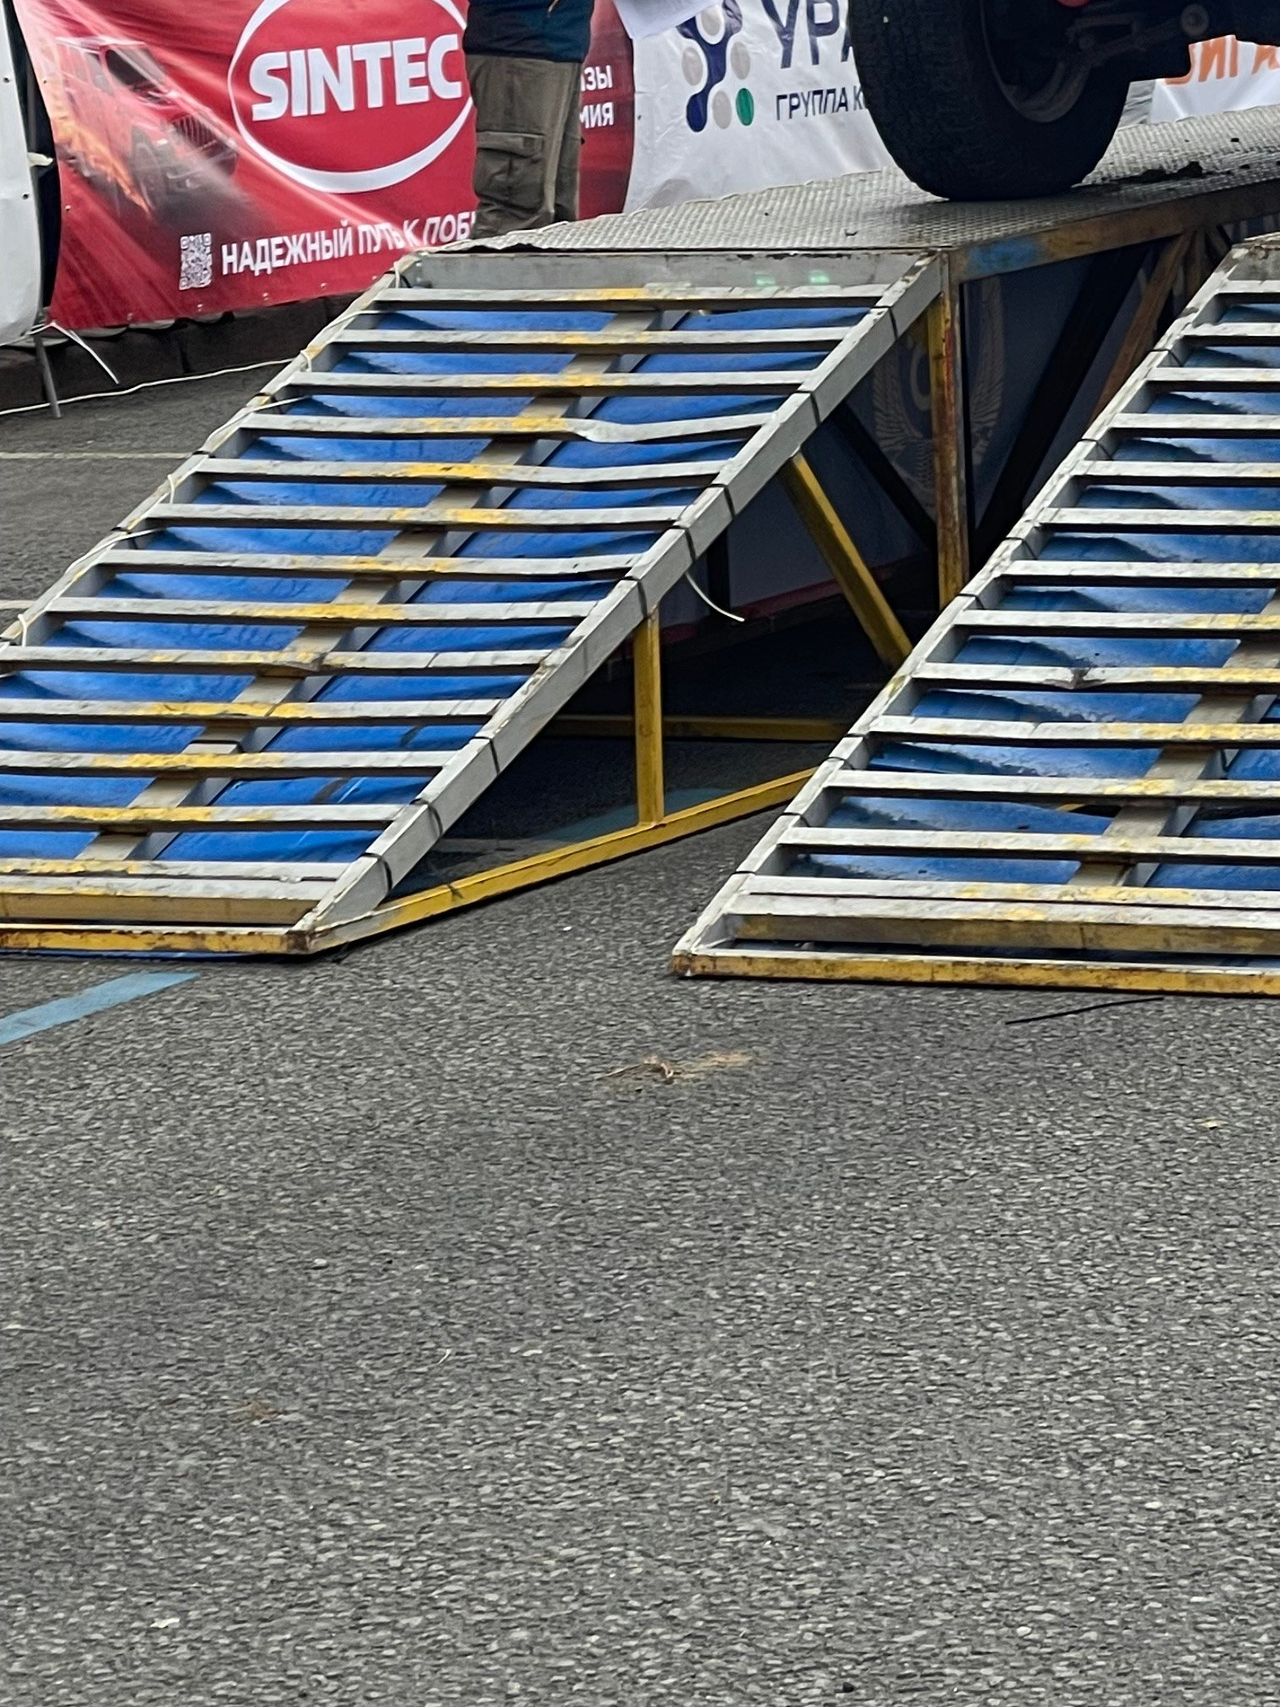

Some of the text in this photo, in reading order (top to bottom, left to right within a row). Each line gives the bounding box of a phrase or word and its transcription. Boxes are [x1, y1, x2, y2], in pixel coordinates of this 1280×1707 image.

[248, 33, 463, 122] SINTEC
[775, 87, 850, 121] ГРУППА
[221, 219, 353, 276] НАДЕЖНЫЙ
[357, 222, 406, 256] ПУТЬ
